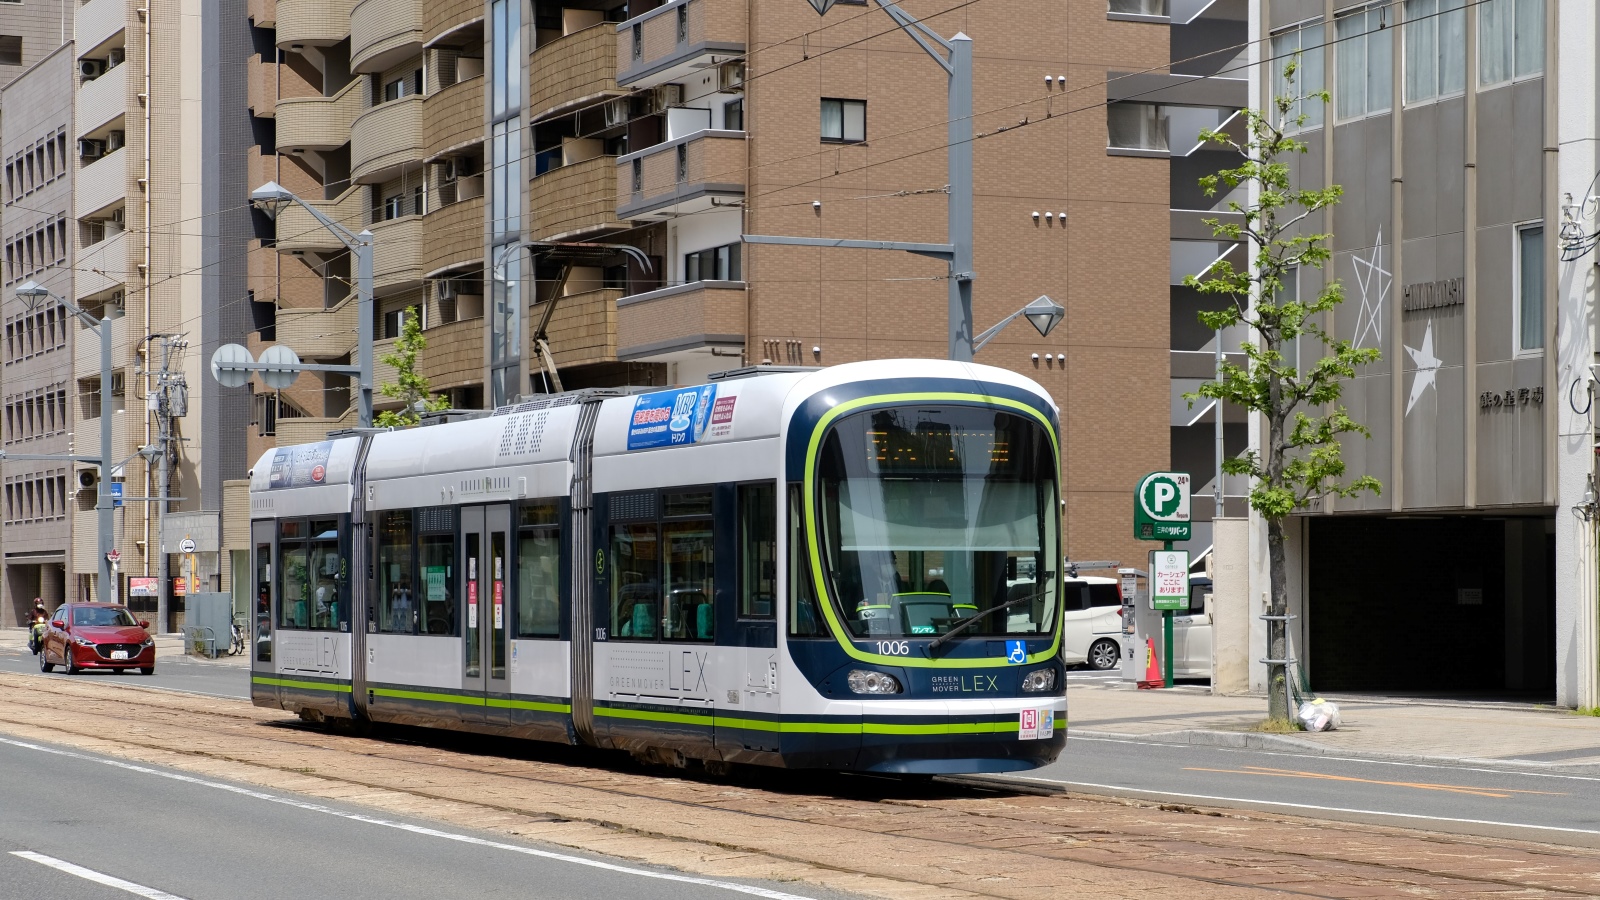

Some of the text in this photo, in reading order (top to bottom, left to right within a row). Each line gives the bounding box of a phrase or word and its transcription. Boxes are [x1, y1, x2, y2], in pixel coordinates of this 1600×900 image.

[673, 391, 697, 418] MBP
[671, 432, 686, 444] ドリンク
[1154, 482, 1175, 512] P
[1157, 526, 1188, 536] 三井のリパーク
[911, 626, 936, 634] ワンマン
[316, 636, 339, 668] LEX
[876, 640, 910, 656] 1006
[610, 651, 708, 692] GREENMOVER LEX
[961, 675, 999, 692] LEX
